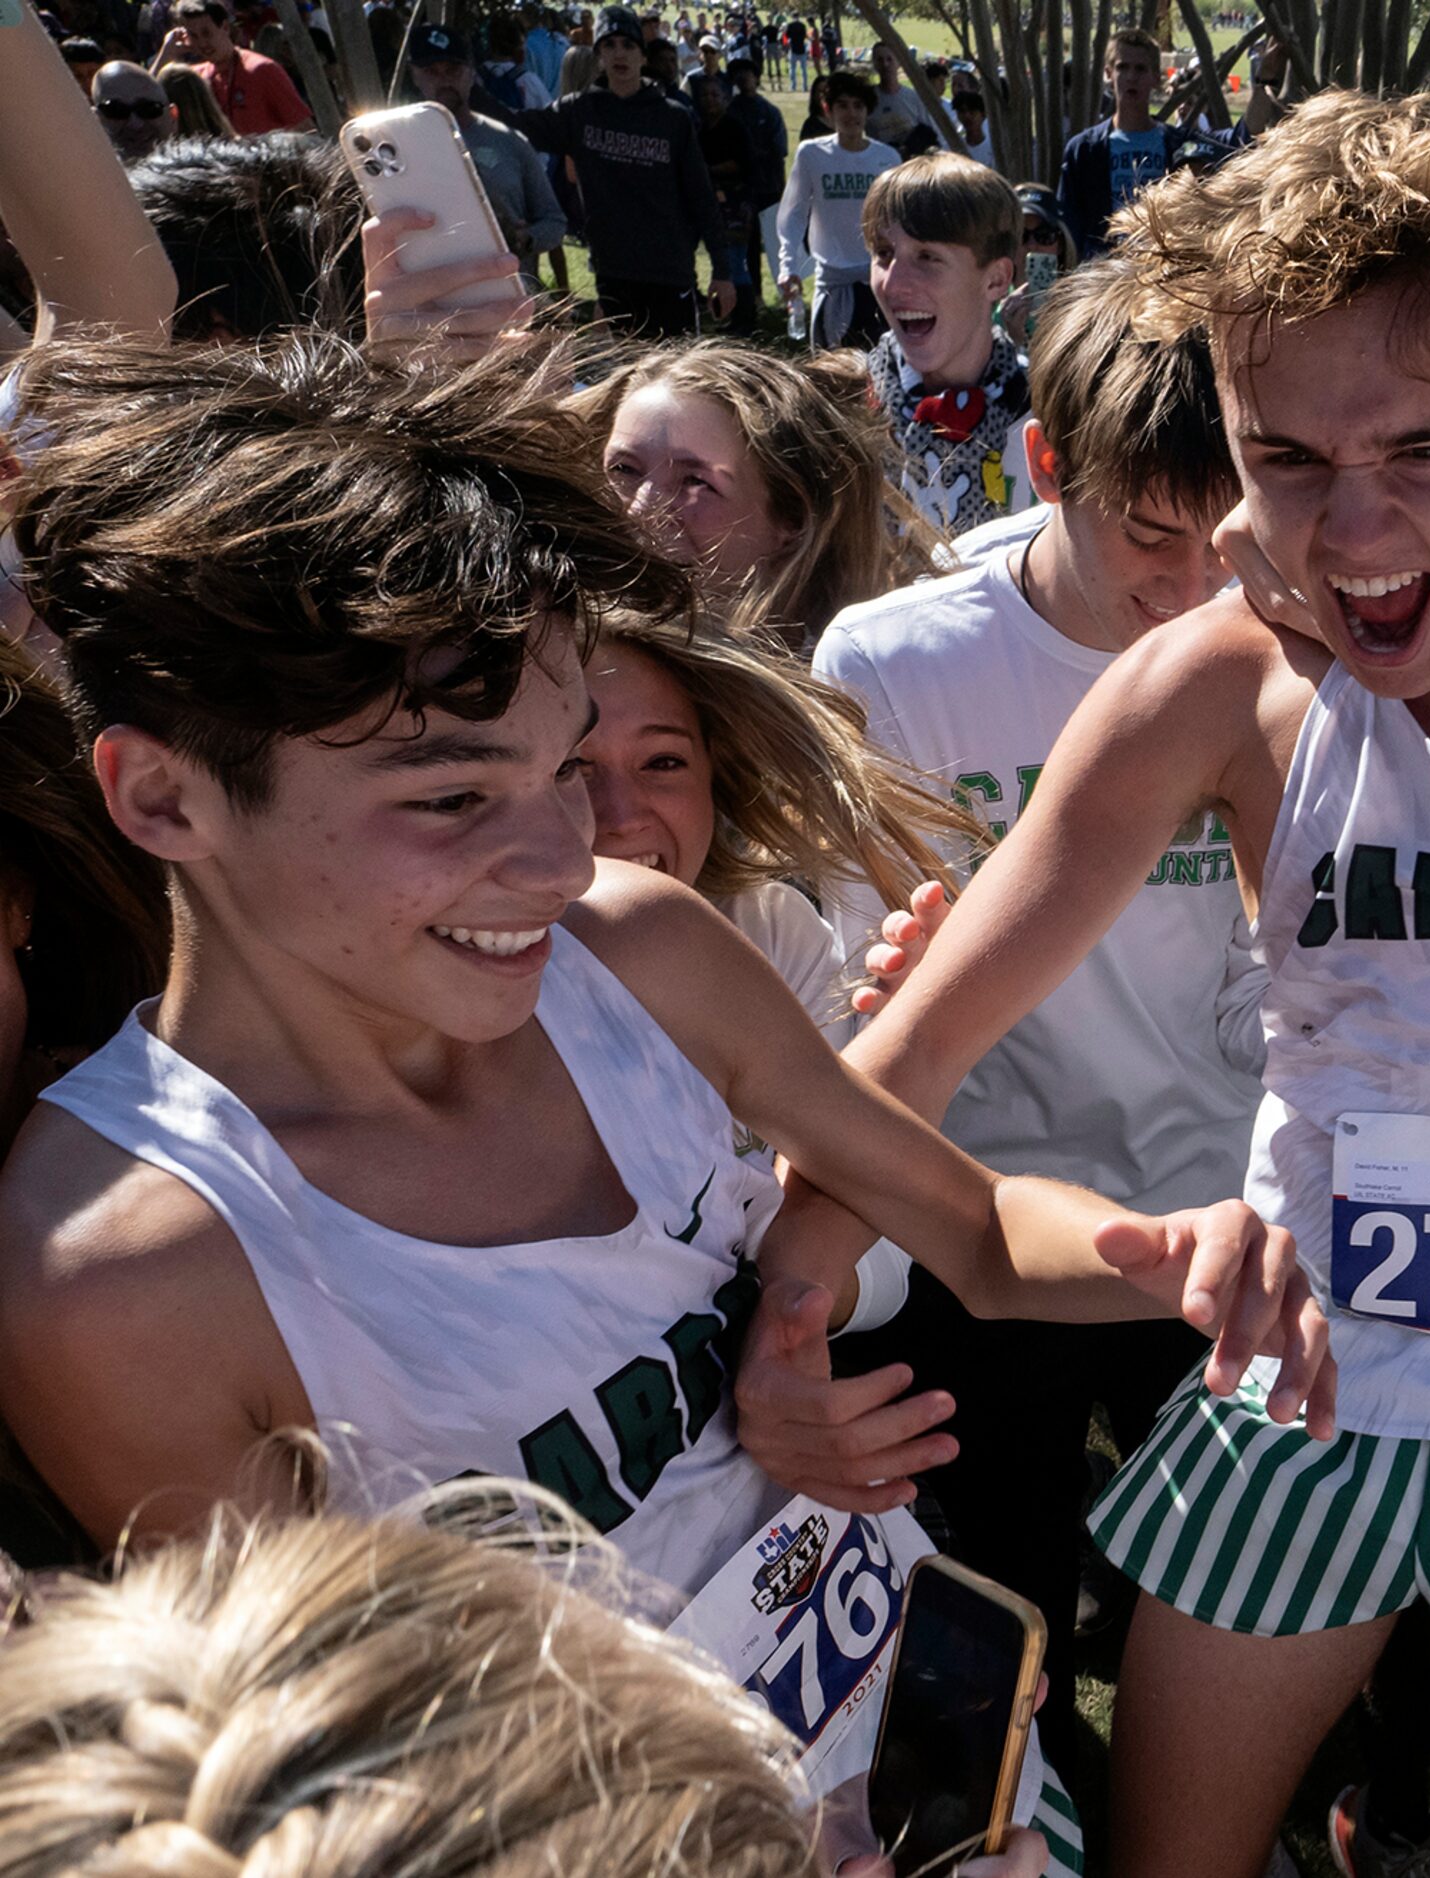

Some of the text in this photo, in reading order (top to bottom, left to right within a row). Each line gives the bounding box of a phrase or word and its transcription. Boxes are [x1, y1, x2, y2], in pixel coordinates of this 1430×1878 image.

[584, 124, 671, 164] ALABAMA
[821, 173, 879, 191] CARRO
[755, 1518, 828, 1612] STATE
[842, 1663, 884, 1717] 2021
